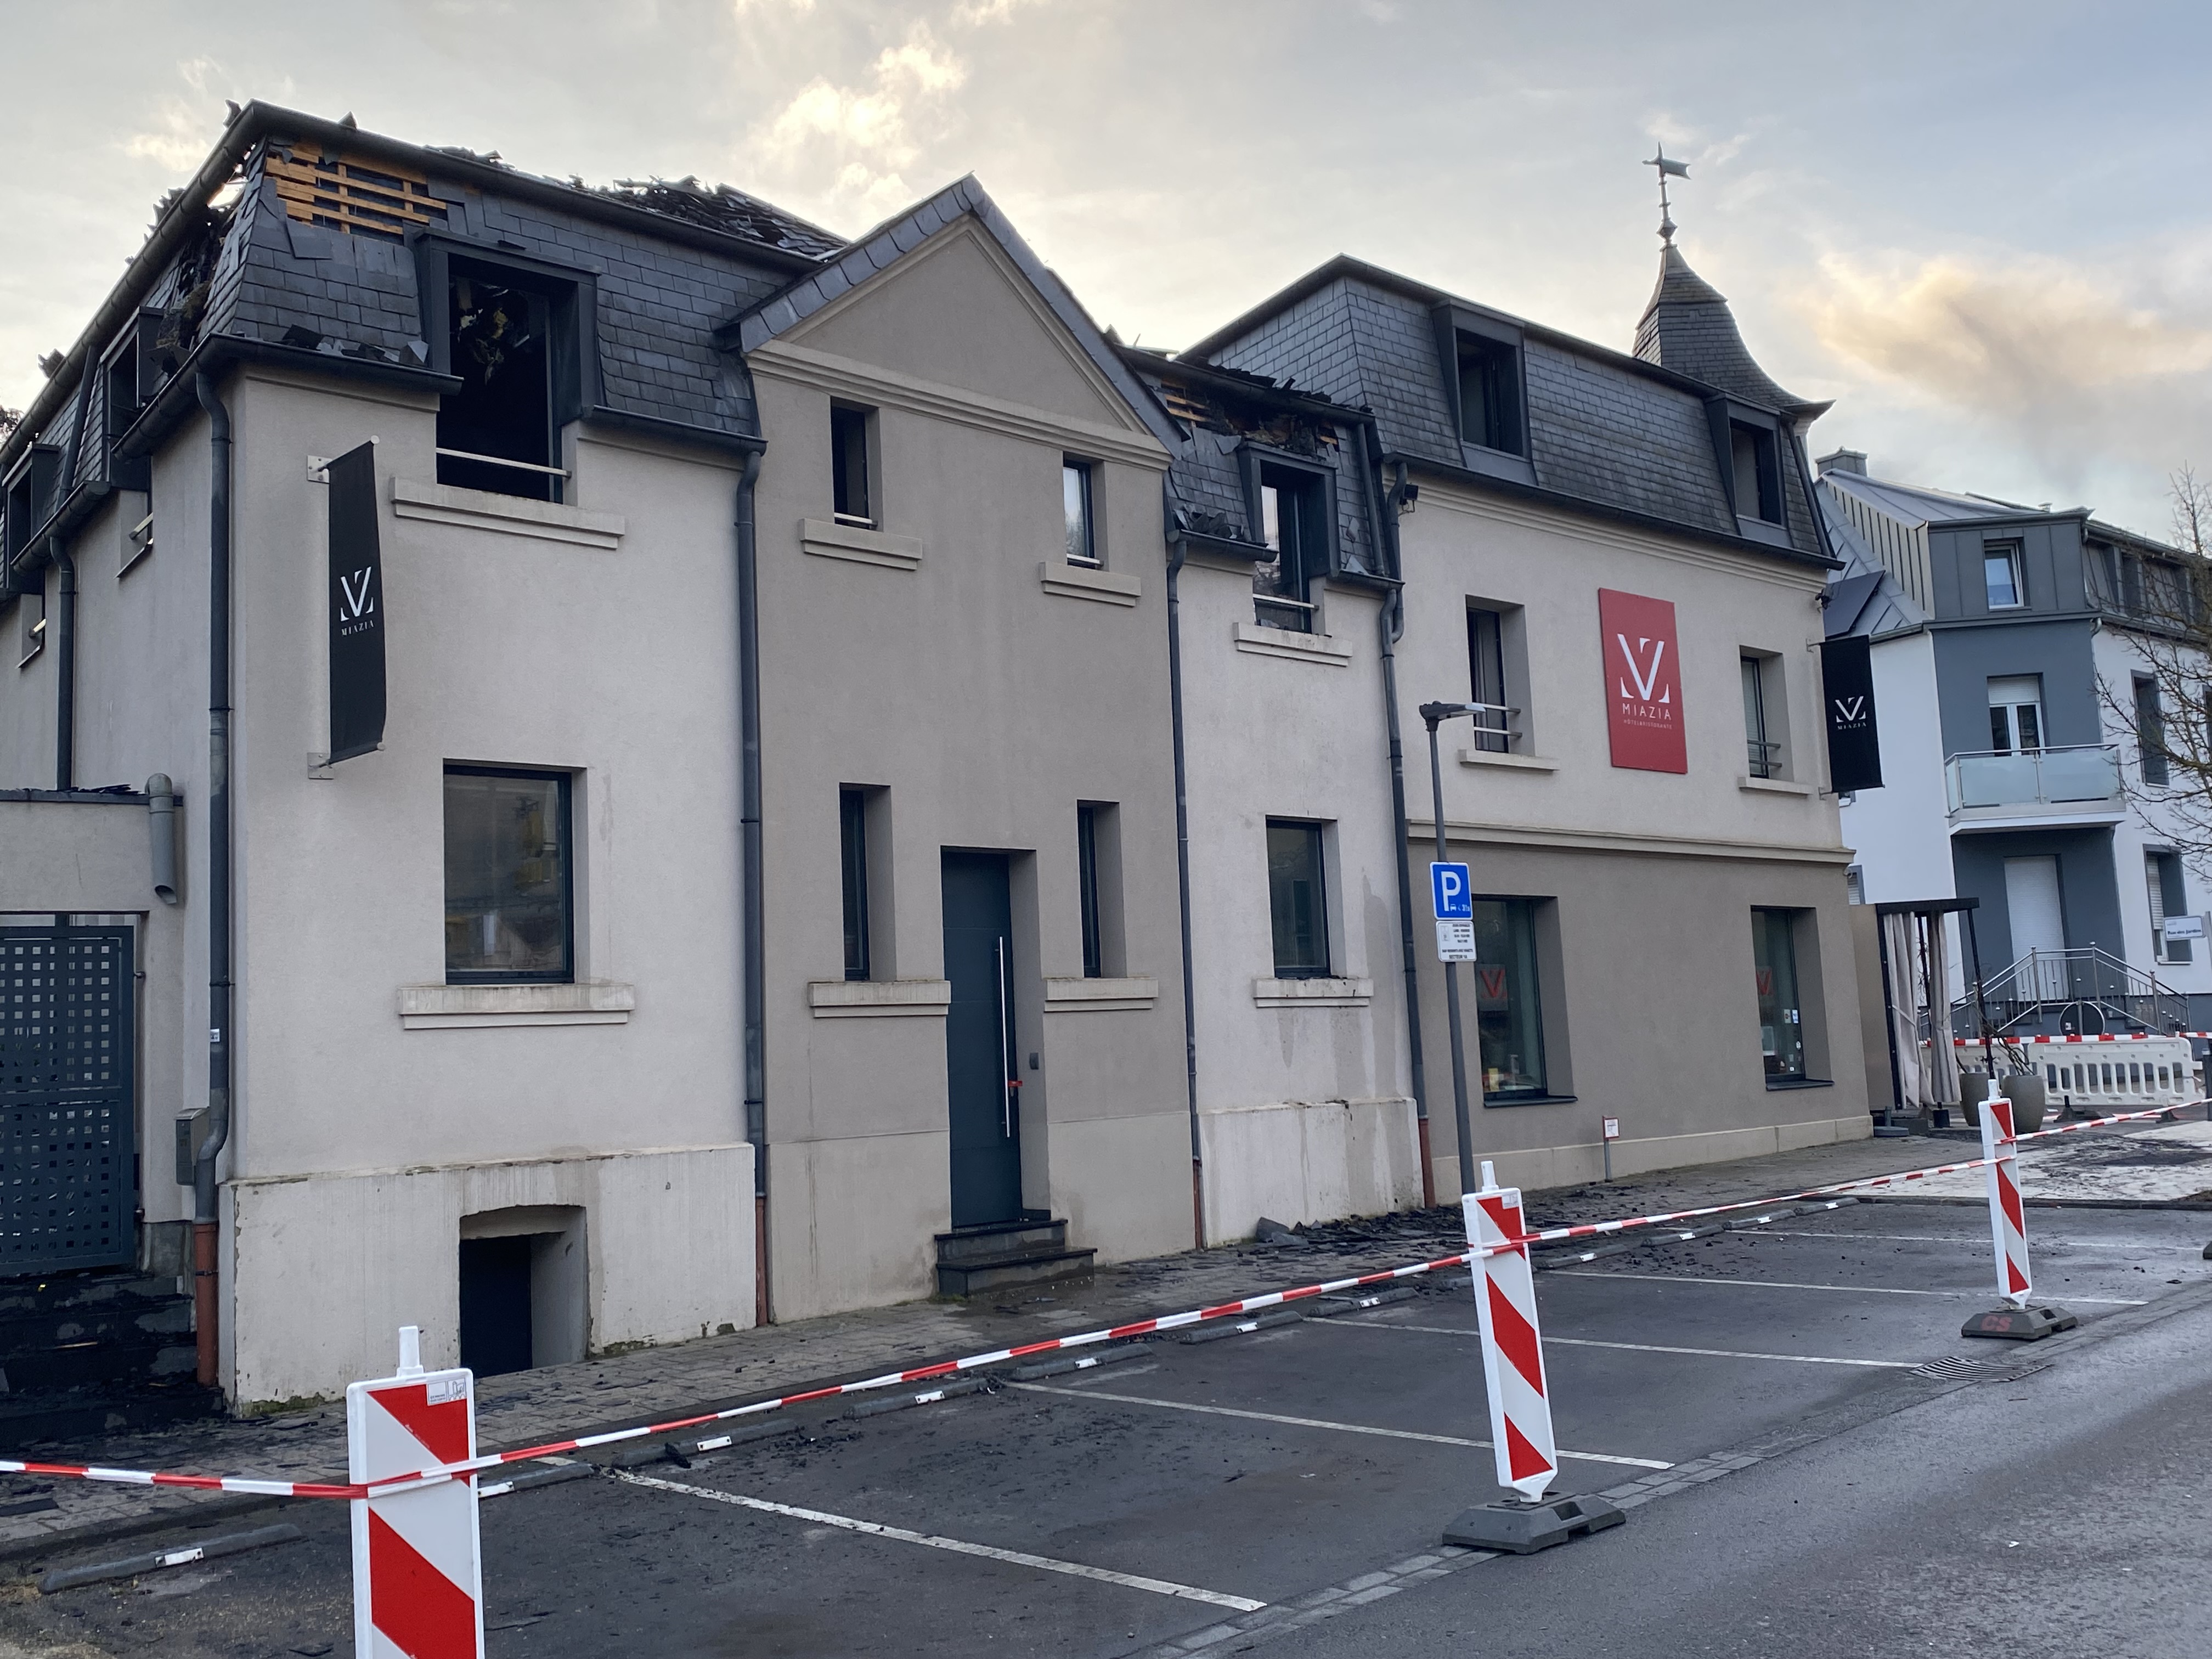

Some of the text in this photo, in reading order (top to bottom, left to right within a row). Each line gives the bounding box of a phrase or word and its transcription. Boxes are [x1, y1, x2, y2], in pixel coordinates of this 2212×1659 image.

[341, 619, 374, 636] MIAZIA
[1622, 703, 1672, 720] MIAZIA
[1837, 721, 1866, 730] MIAZIA
[1440, 871, 1462, 912] P
